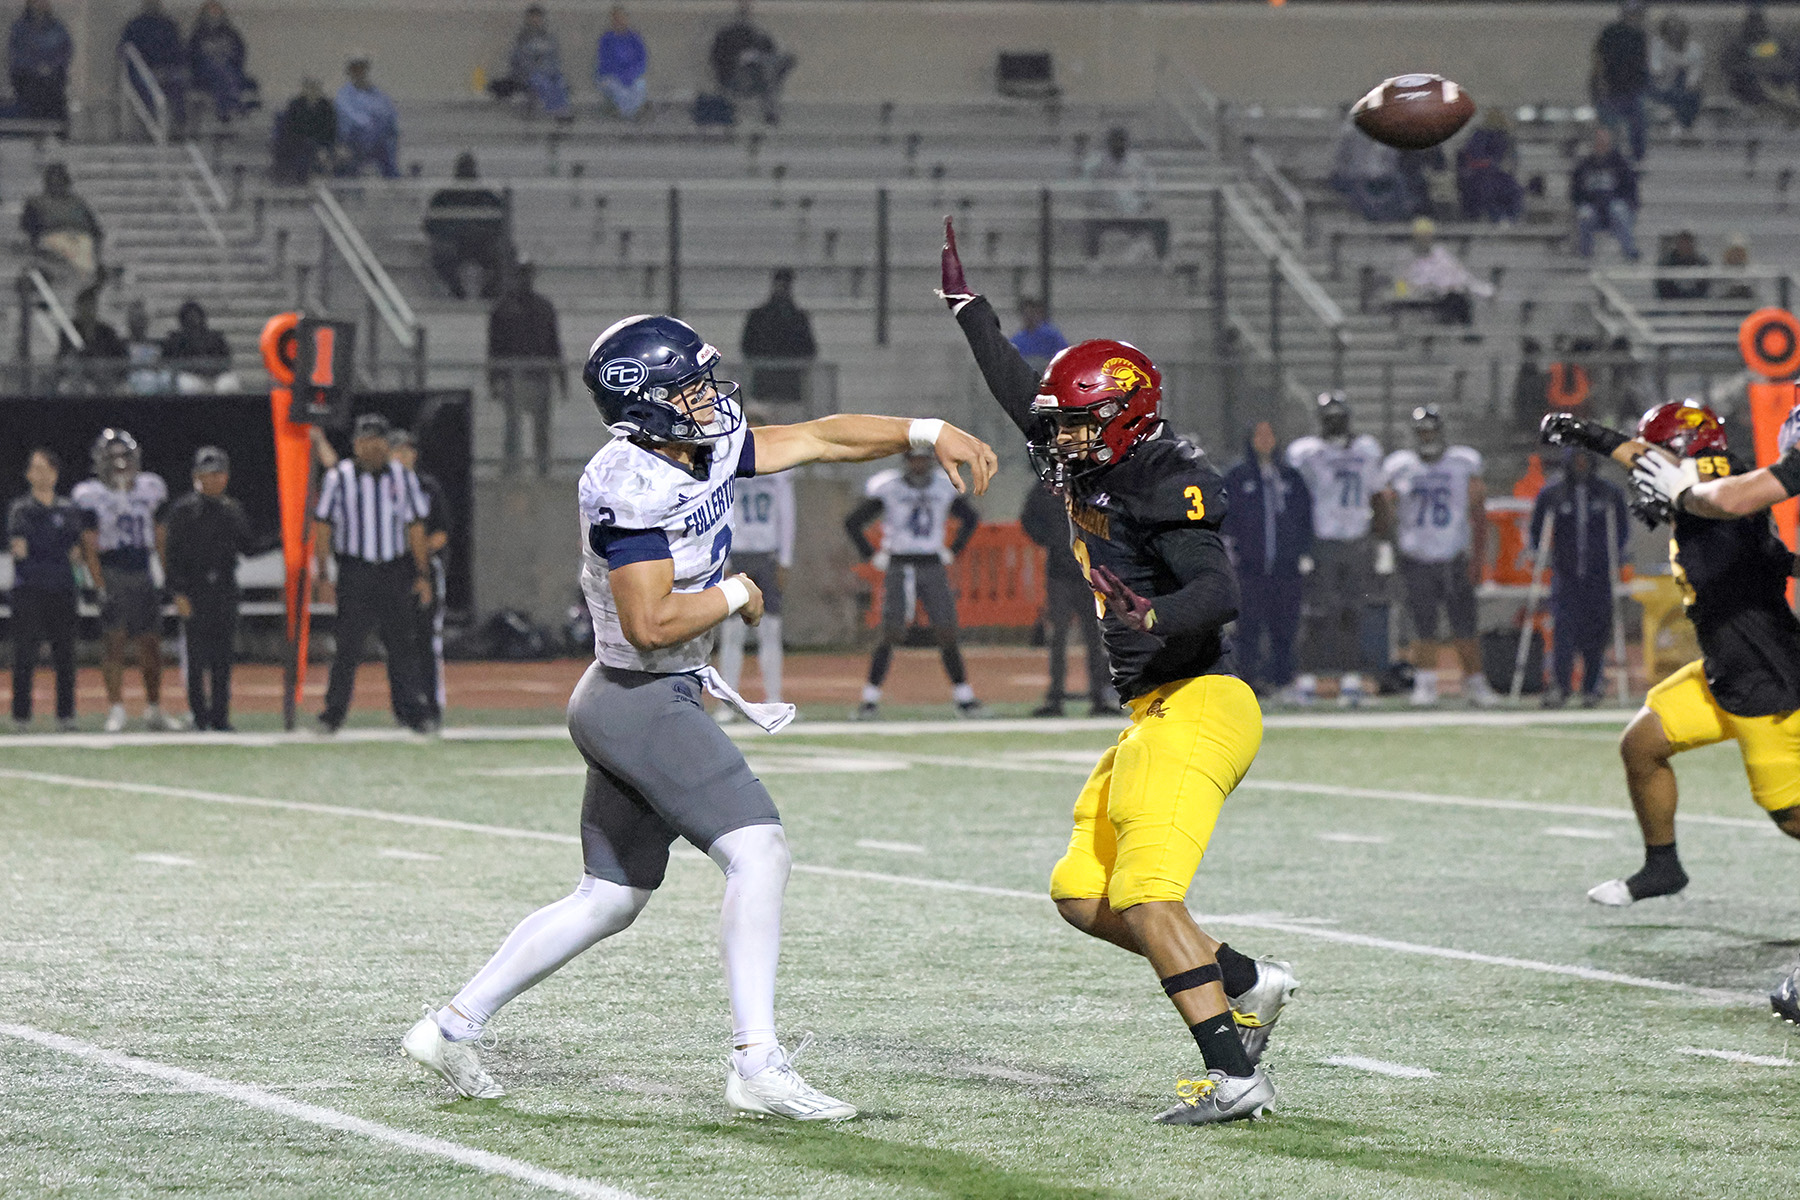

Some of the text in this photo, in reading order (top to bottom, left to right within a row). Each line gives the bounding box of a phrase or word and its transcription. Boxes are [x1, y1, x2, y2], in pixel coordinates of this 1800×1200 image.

[606, 365, 639, 384] FC
[1697, 456, 1731, 477] 55
[598, 507, 616, 527] 2
[682, 470, 737, 537] FULLERTO
[741, 492, 772, 523] 10
[1183, 485, 1205, 521] 3
[1411, 486, 1451, 527] 76
